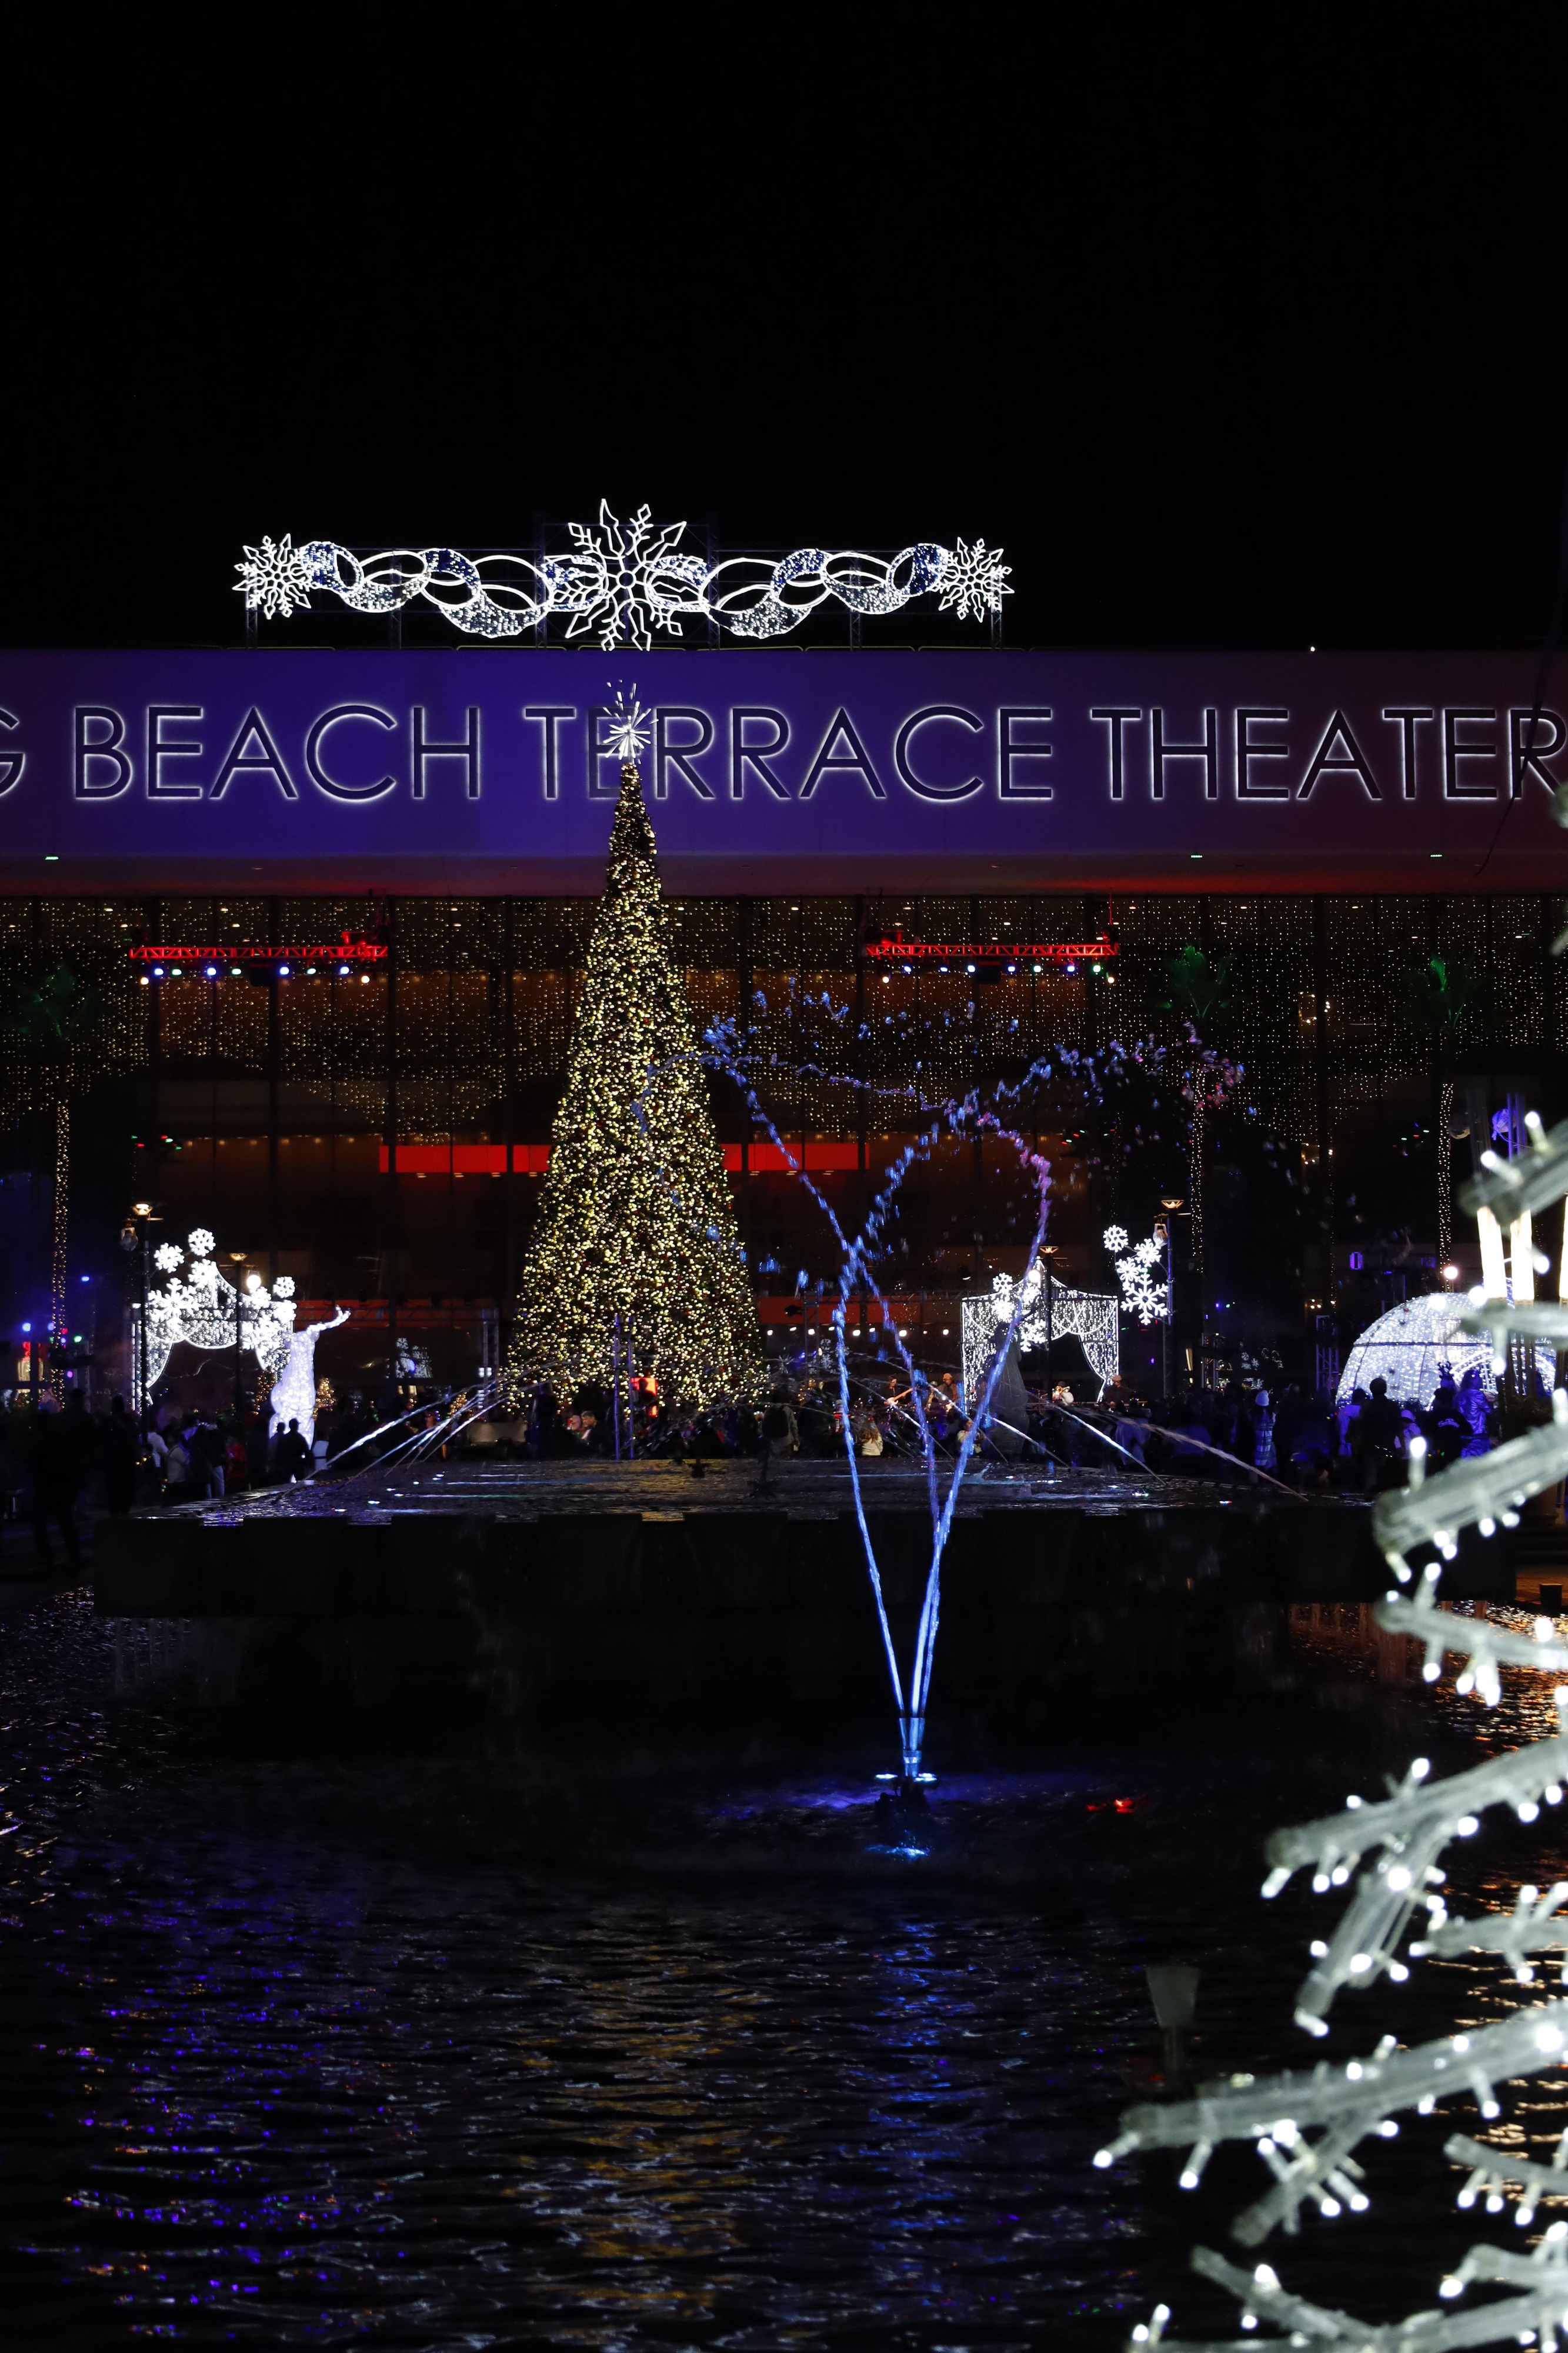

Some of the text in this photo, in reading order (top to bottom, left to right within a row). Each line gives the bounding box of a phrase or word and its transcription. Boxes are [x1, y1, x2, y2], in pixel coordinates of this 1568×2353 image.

[74, 705, 479, 800] BEACH
[522, 706, 1053, 800] TERRACE
[1090, 708, 1568, 801] THEATER
